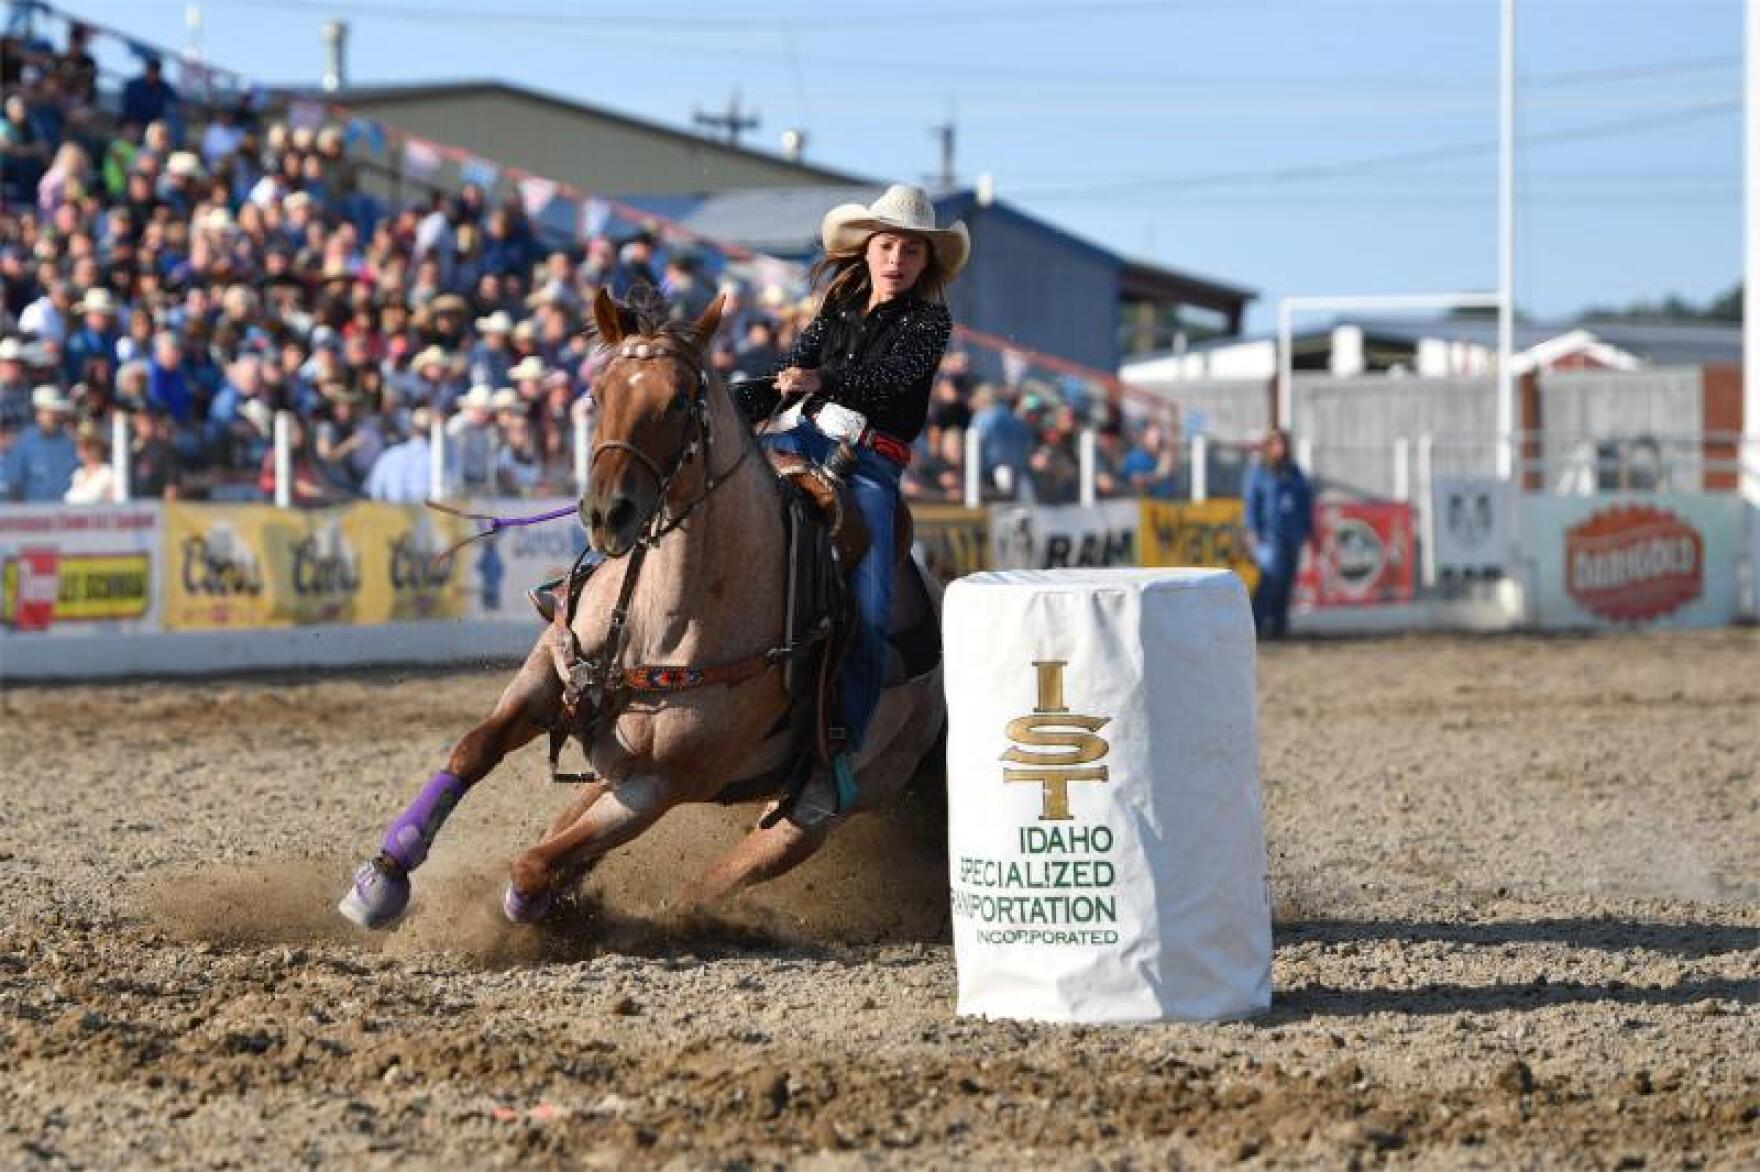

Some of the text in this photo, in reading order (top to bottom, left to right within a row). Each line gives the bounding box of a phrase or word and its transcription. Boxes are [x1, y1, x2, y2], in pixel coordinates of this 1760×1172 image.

[1046, 528, 1138, 568] RAM
[1576, 536, 1696, 589] DARIGOLD
[1019, 826, 1114, 854] IDAHO
[977, 929, 1119, 945] INCORPORATED
